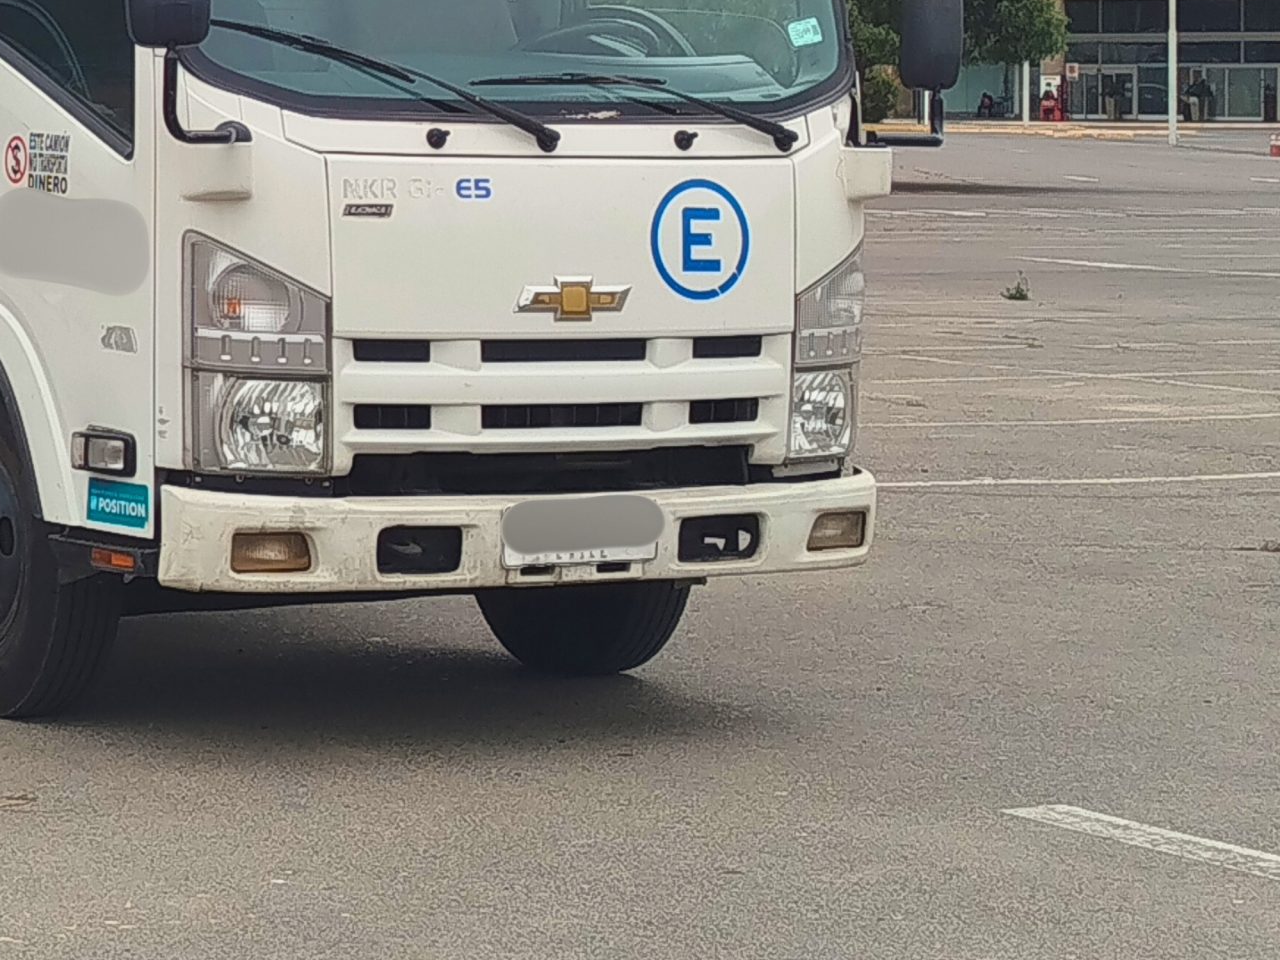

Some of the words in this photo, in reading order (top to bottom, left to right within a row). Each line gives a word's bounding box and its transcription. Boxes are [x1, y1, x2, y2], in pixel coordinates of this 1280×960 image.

[27, 173, 69, 195] DINERO
[342, 178, 398, 200] NKR
[455, 178, 492, 199] E5
[681, 206, 722, 272] E
[98, 496, 147, 518] POSITION
